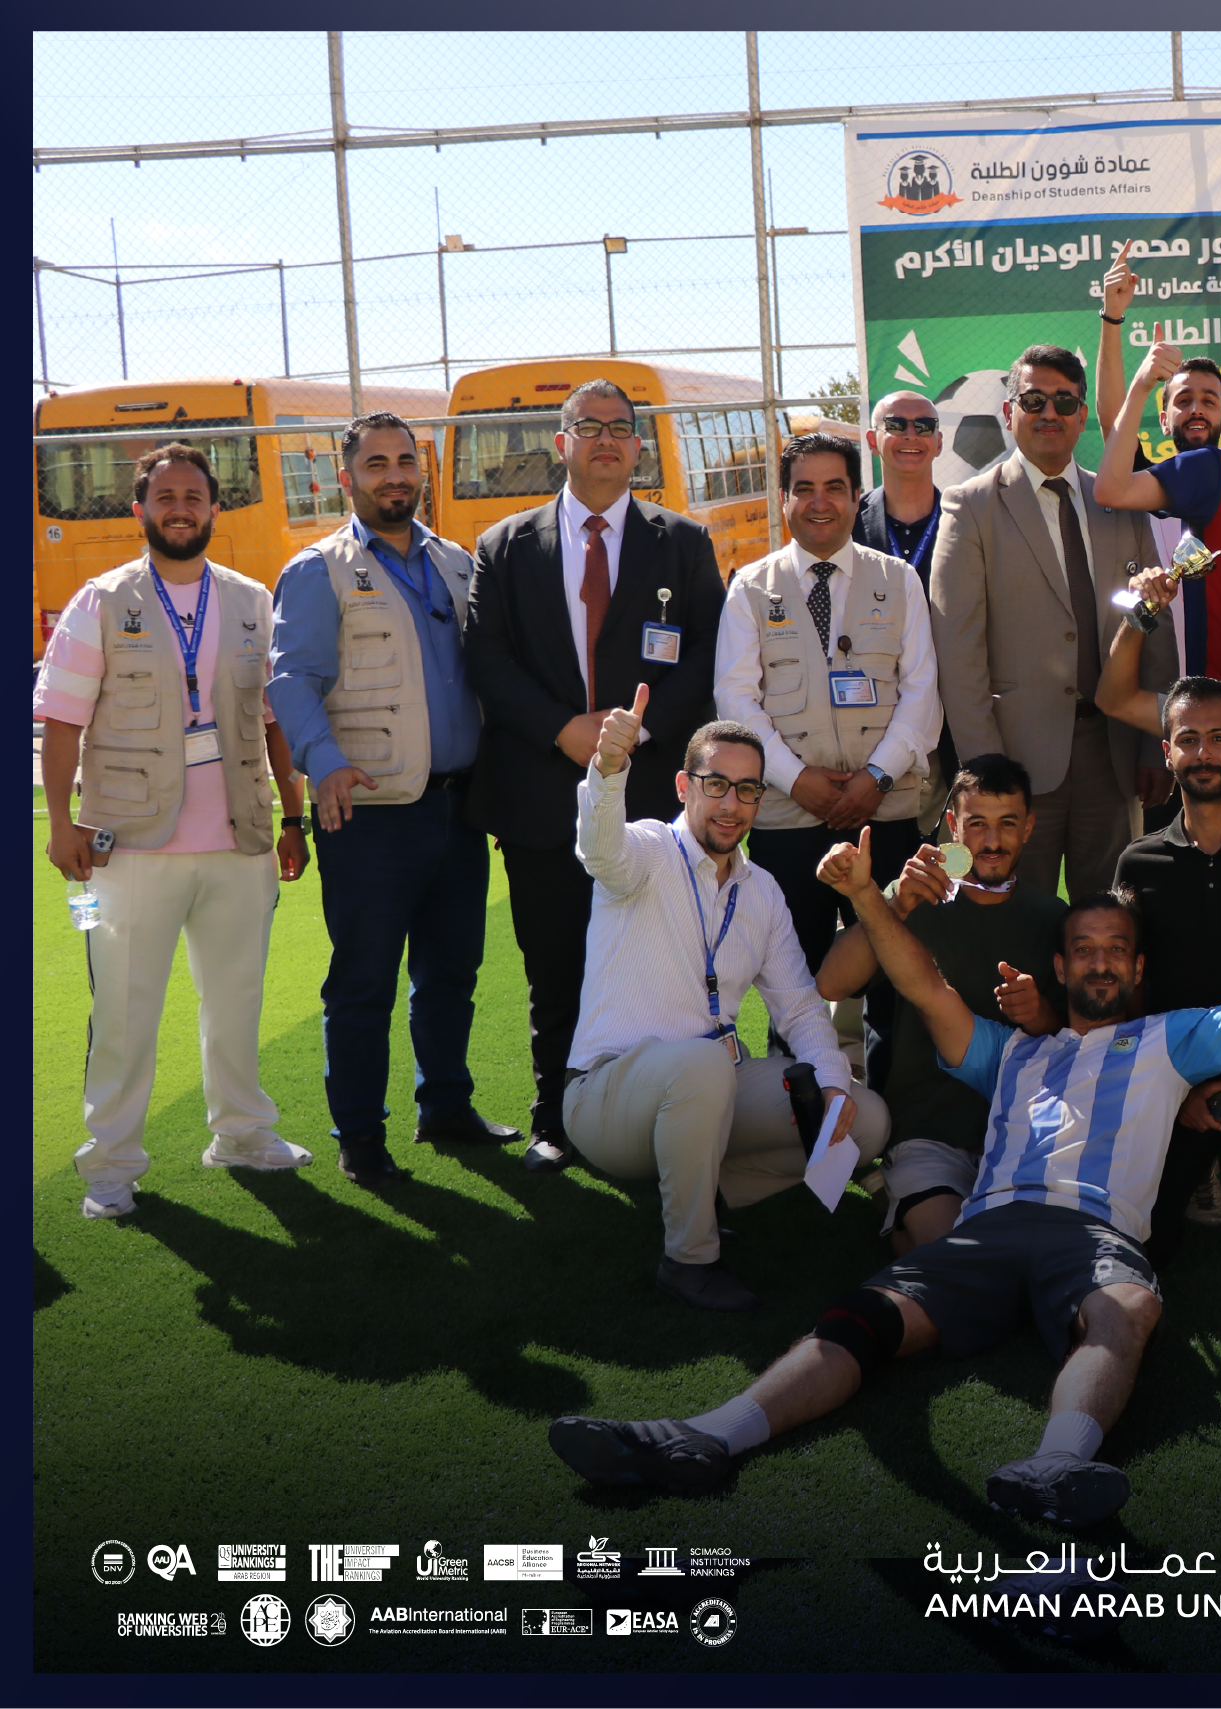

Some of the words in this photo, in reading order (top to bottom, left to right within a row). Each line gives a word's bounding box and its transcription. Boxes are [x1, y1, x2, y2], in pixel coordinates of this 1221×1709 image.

[970, 160, 1026, 184] الطلبة
[1031, 154, 1088, 182] شؤون
[1094, 155, 1150, 174] عمادة
[972, 189, 1031, 203] Deanship
[1034, 188, 1047, 200] of
[1049, 184, 1106, 199] Students
[1109, 183, 1151, 195] Affairs
[895, 239, 984, 279] الأكرم
[992, 235, 1102, 272] الوديان
[1111, 238, 1191, 260] محمد
[1158, 277, 1204, 300] عمان
